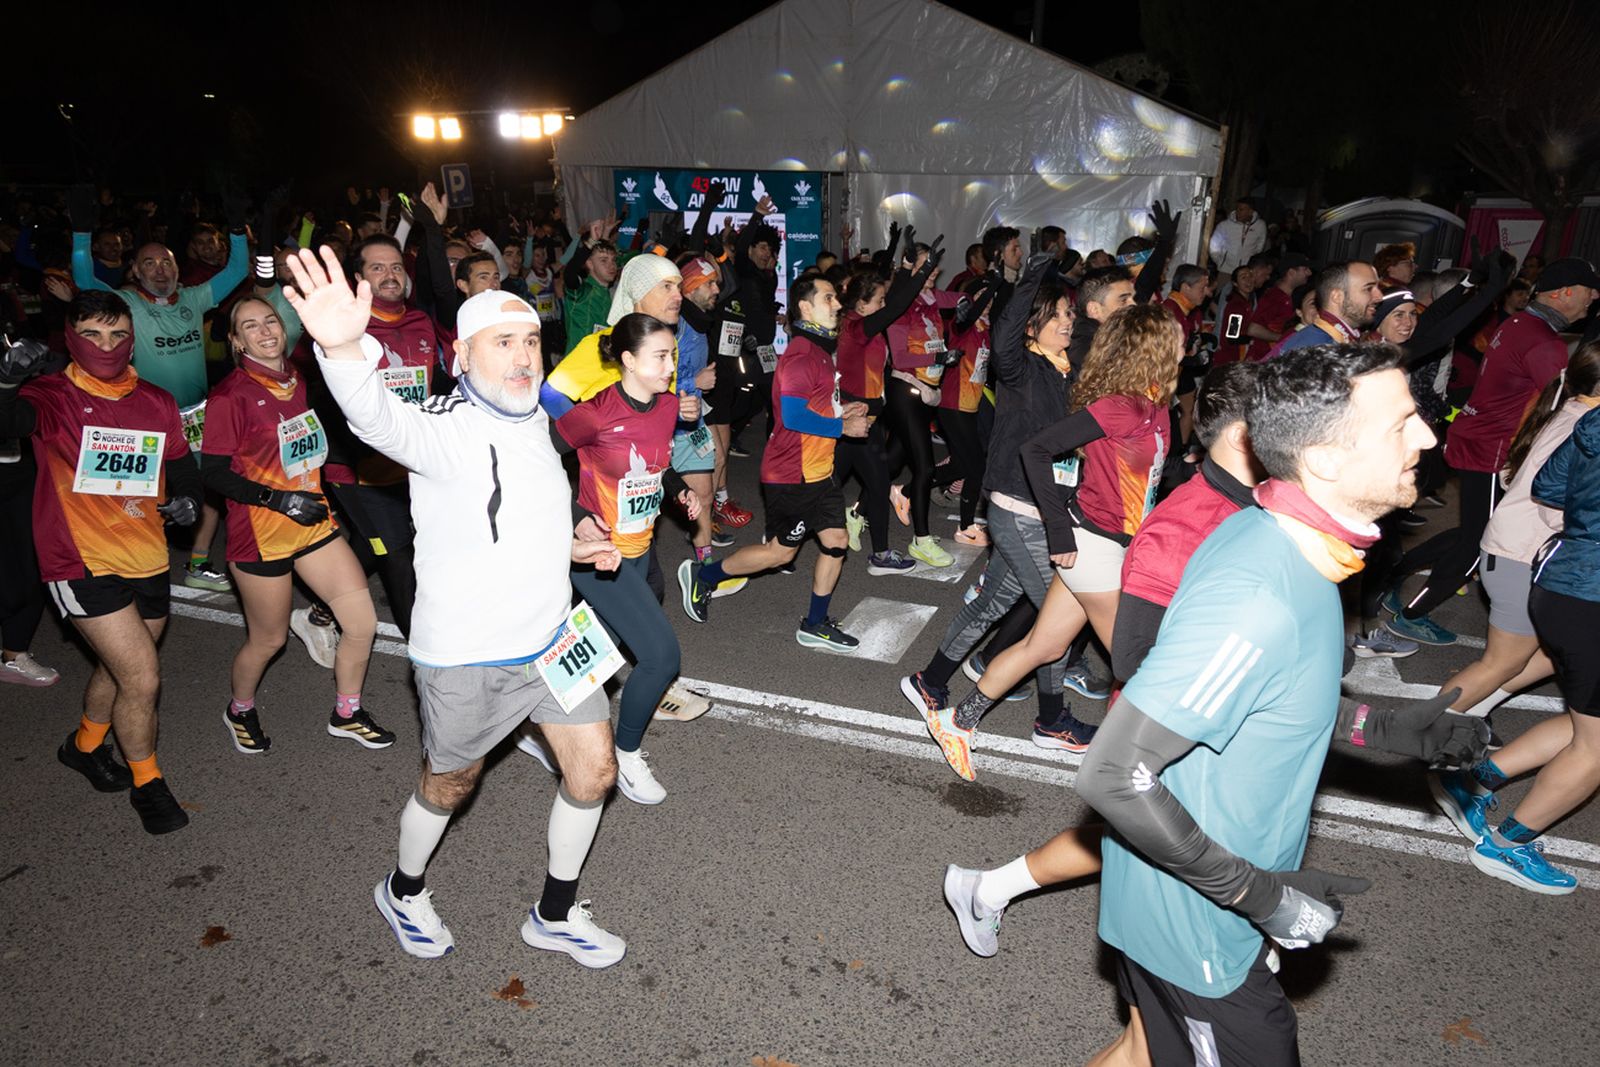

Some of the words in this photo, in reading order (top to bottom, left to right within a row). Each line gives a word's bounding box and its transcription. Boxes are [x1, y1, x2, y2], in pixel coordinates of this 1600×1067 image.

[449, 169, 465, 195] P
[691, 176, 709, 193] 43
[154, 329, 200, 348] serás
[91, 443, 108, 451] SAN
[102, 435, 125, 444] NOCHE
[290, 432, 319, 459] 2647
[95, 452, 148, 474] 2648
[625, 489, 639, 497] SAN
[543, 650, 558, 665] SAN
[558, 636, 597, 677] 1191
